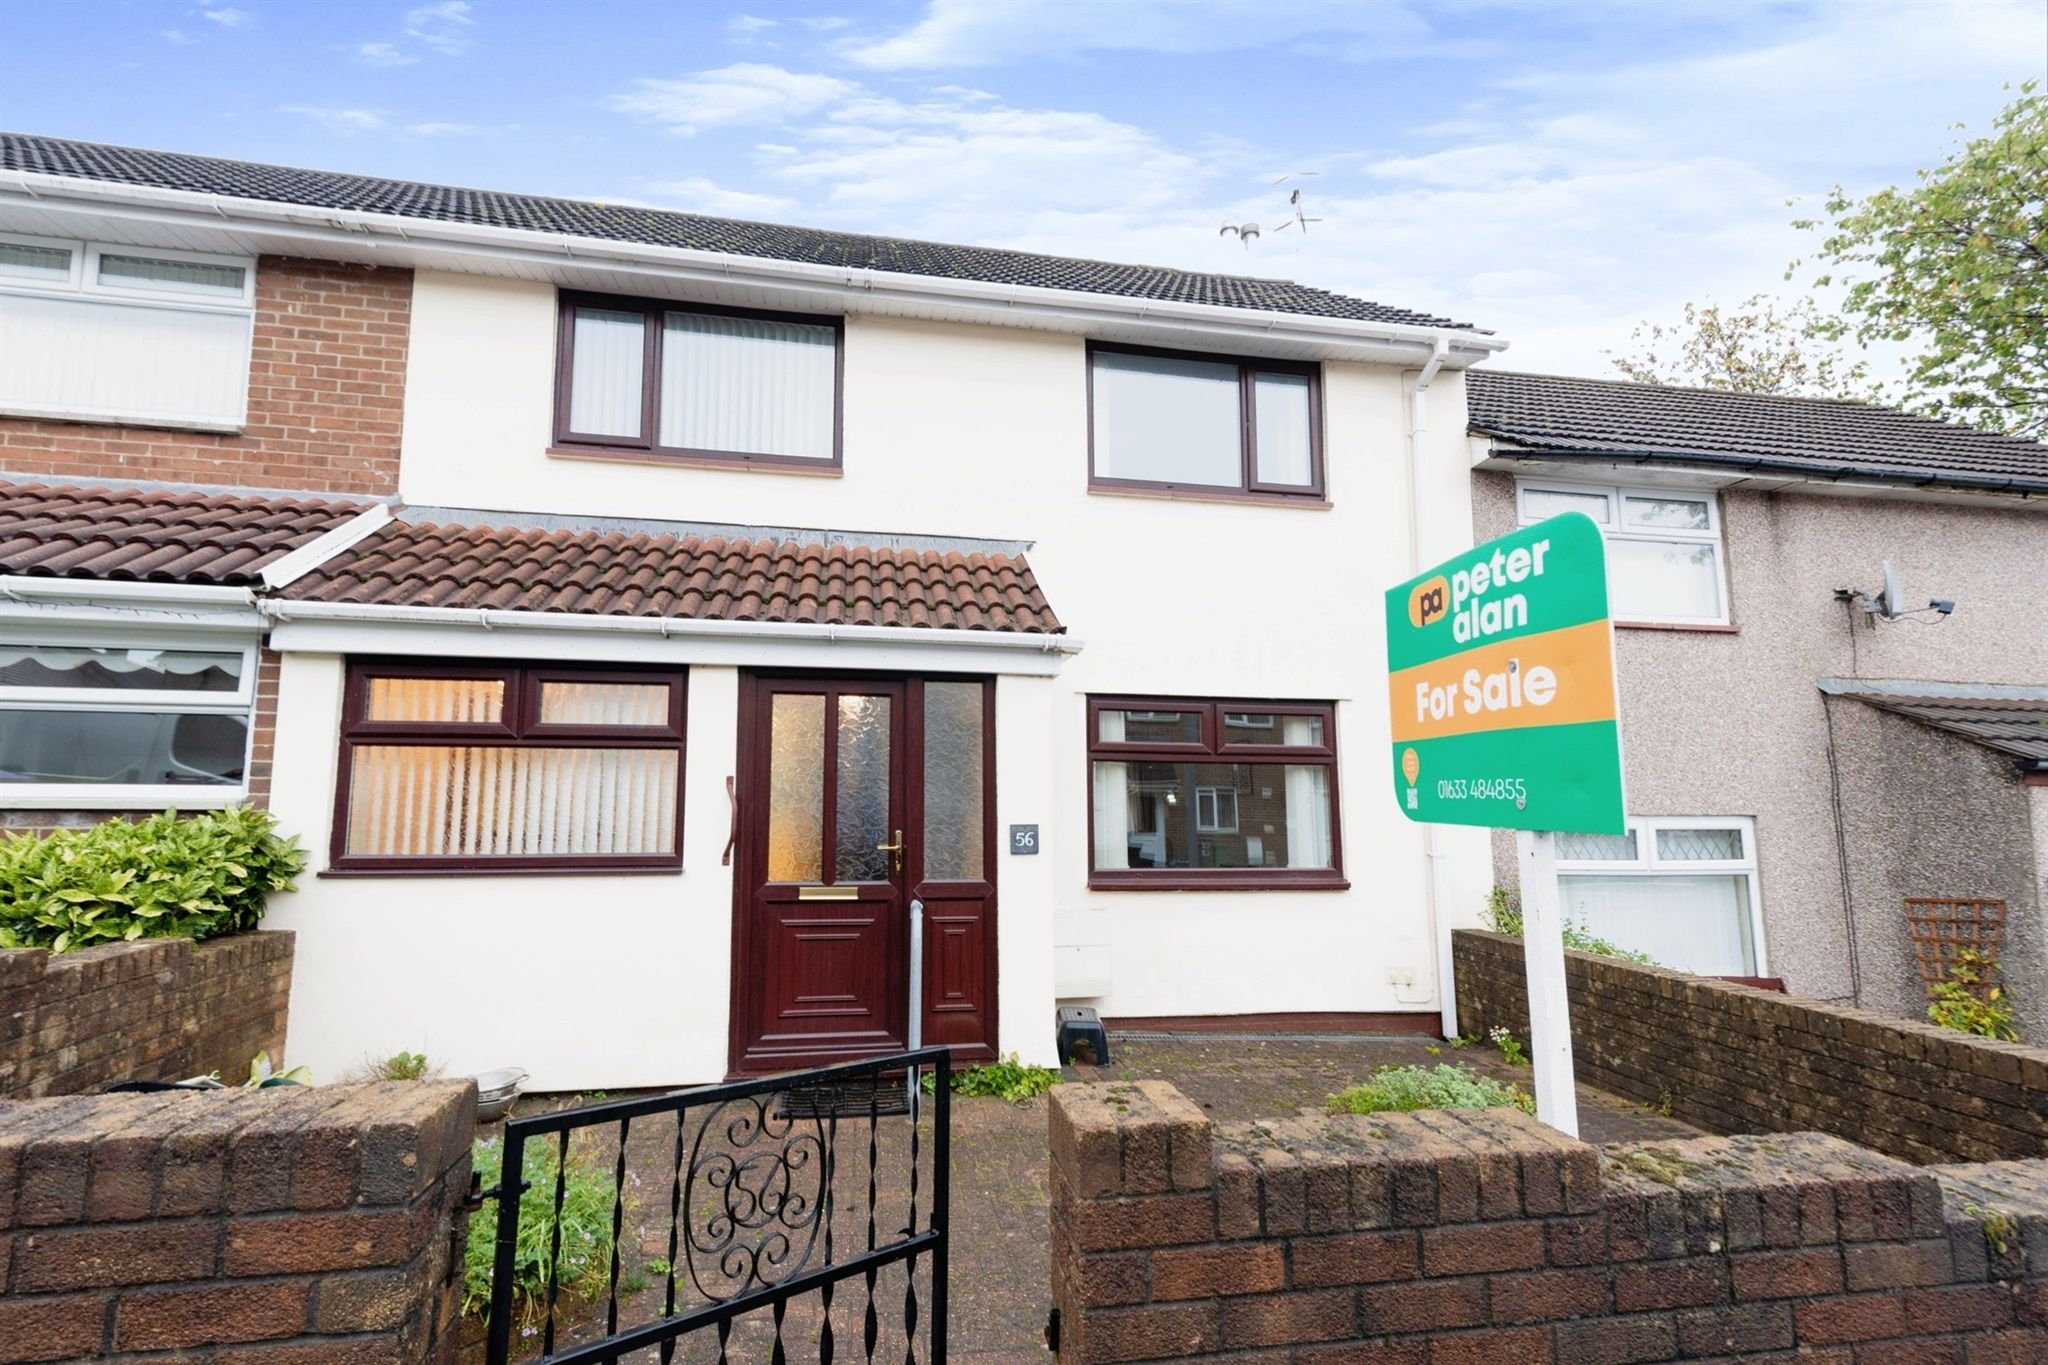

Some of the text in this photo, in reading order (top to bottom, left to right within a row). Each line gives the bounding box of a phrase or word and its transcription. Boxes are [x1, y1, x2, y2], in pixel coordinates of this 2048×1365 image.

[1452, 539, 1550, 613] peter
[1420, 587, 1443, 626] pa
[1453, 594, 1528, 643] alan
[1416, 658, 1557, 722] For Sale
[1437, 778, 1527, 800] 01633 484855
[1015, 831, 1034, 846] 56
[731, 1158, 782, 1222] 56
